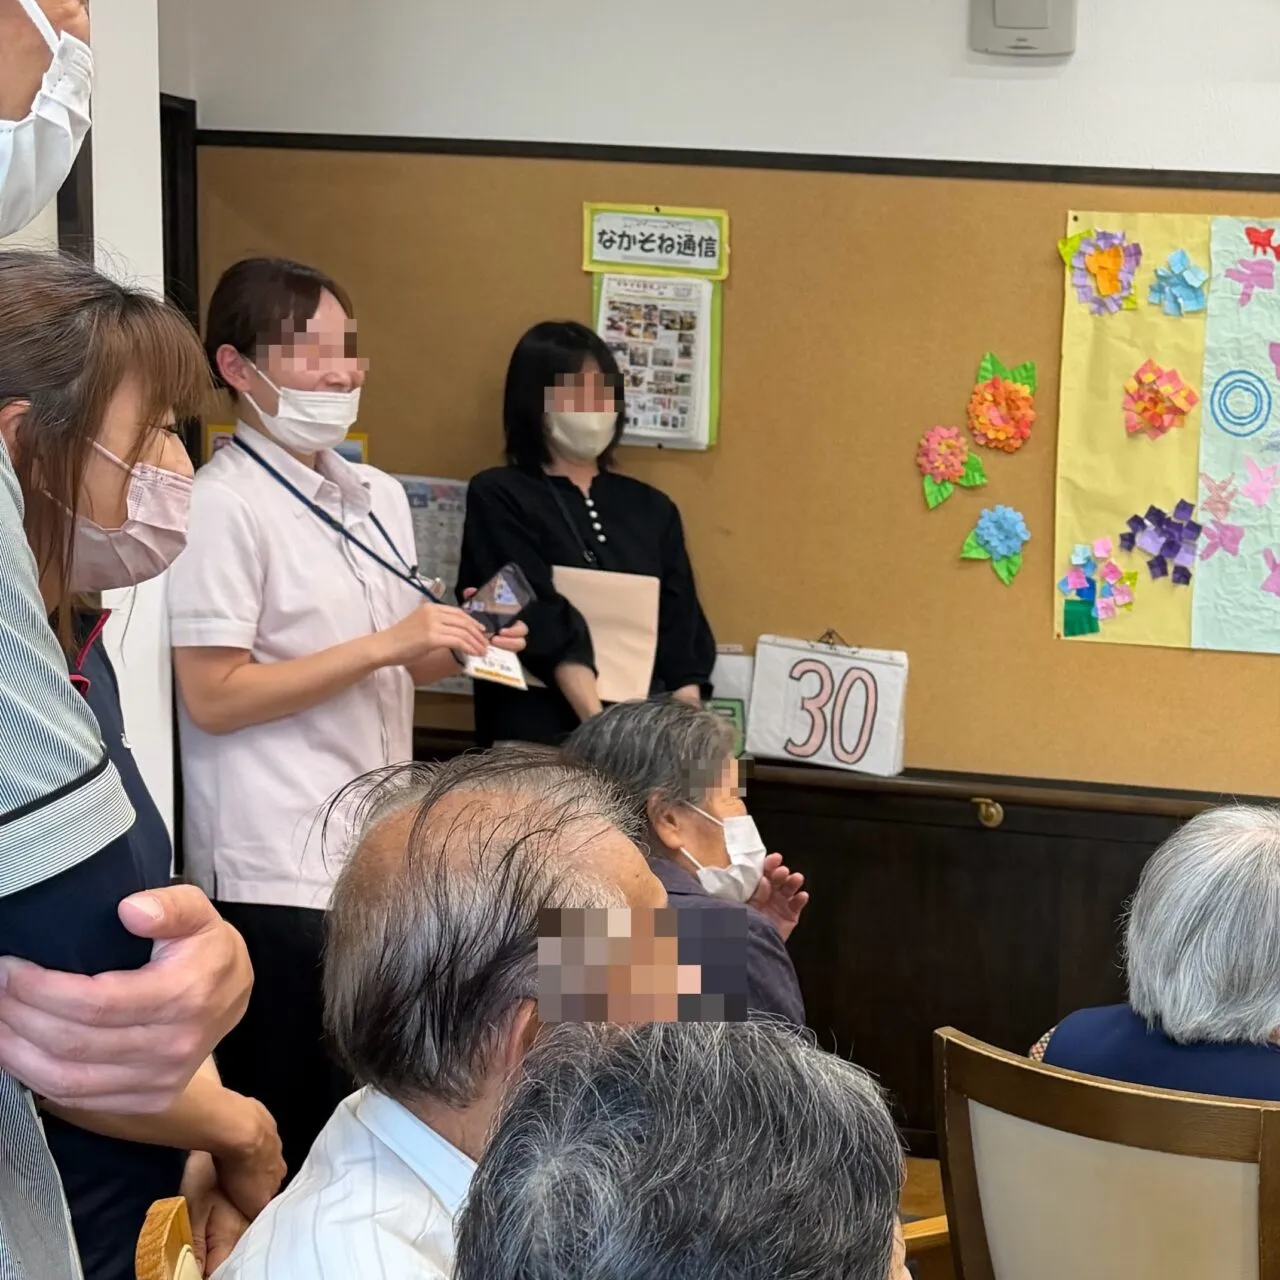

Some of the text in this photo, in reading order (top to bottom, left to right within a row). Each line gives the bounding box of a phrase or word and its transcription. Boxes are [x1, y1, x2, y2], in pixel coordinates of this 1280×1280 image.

[597, 229, 718, 258] なかそね通信
[784, 658, 878, 765] 30
